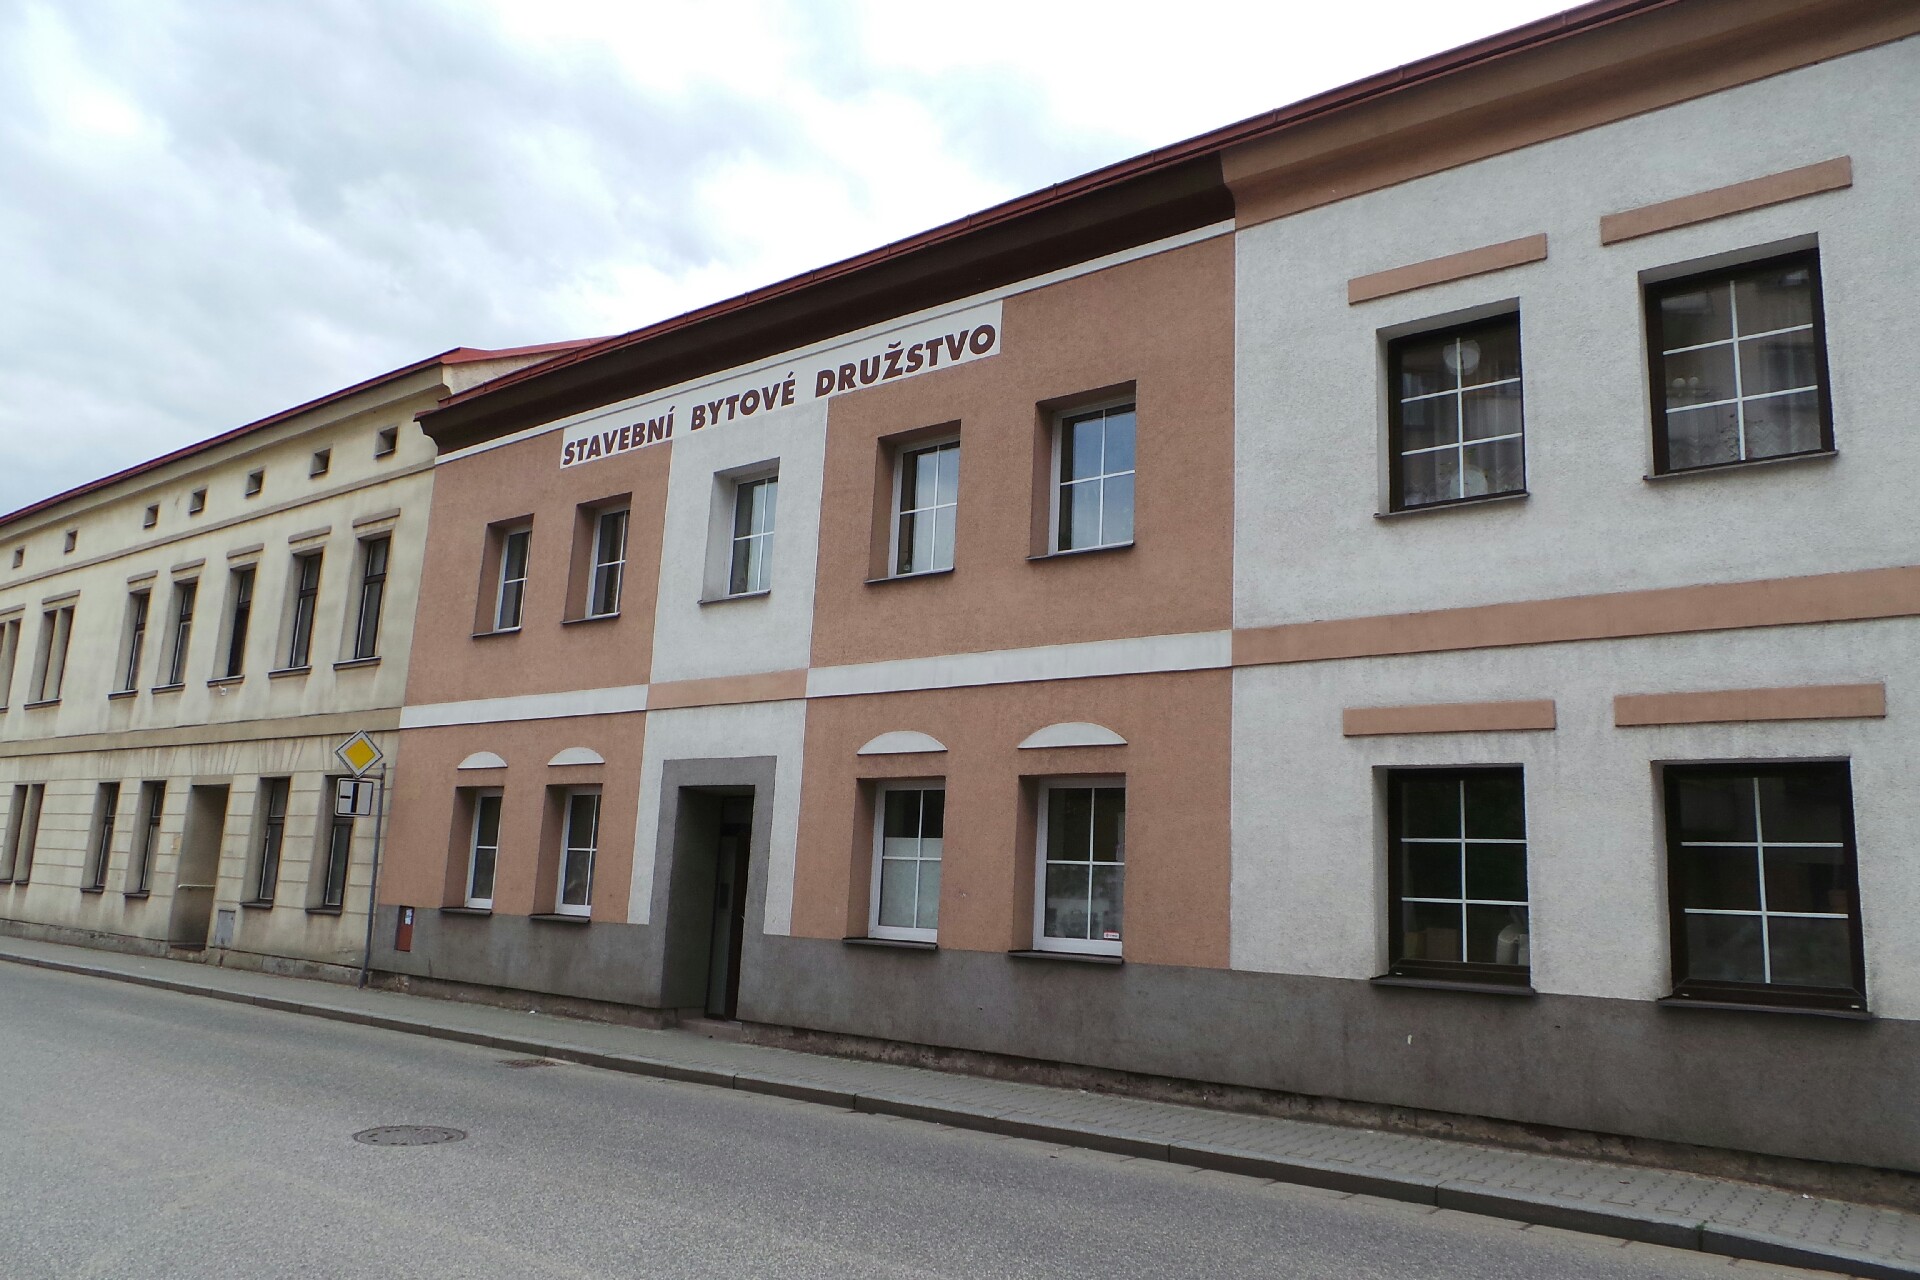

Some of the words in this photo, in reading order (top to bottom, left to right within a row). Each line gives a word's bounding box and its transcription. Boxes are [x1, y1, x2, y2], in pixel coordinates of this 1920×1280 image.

[562, 406, 674, 466] STAVEBNÍ
[690, 372, 796, 431] BYTOVÉ
[814, 324, 997, 398] DRUŽSTVO
